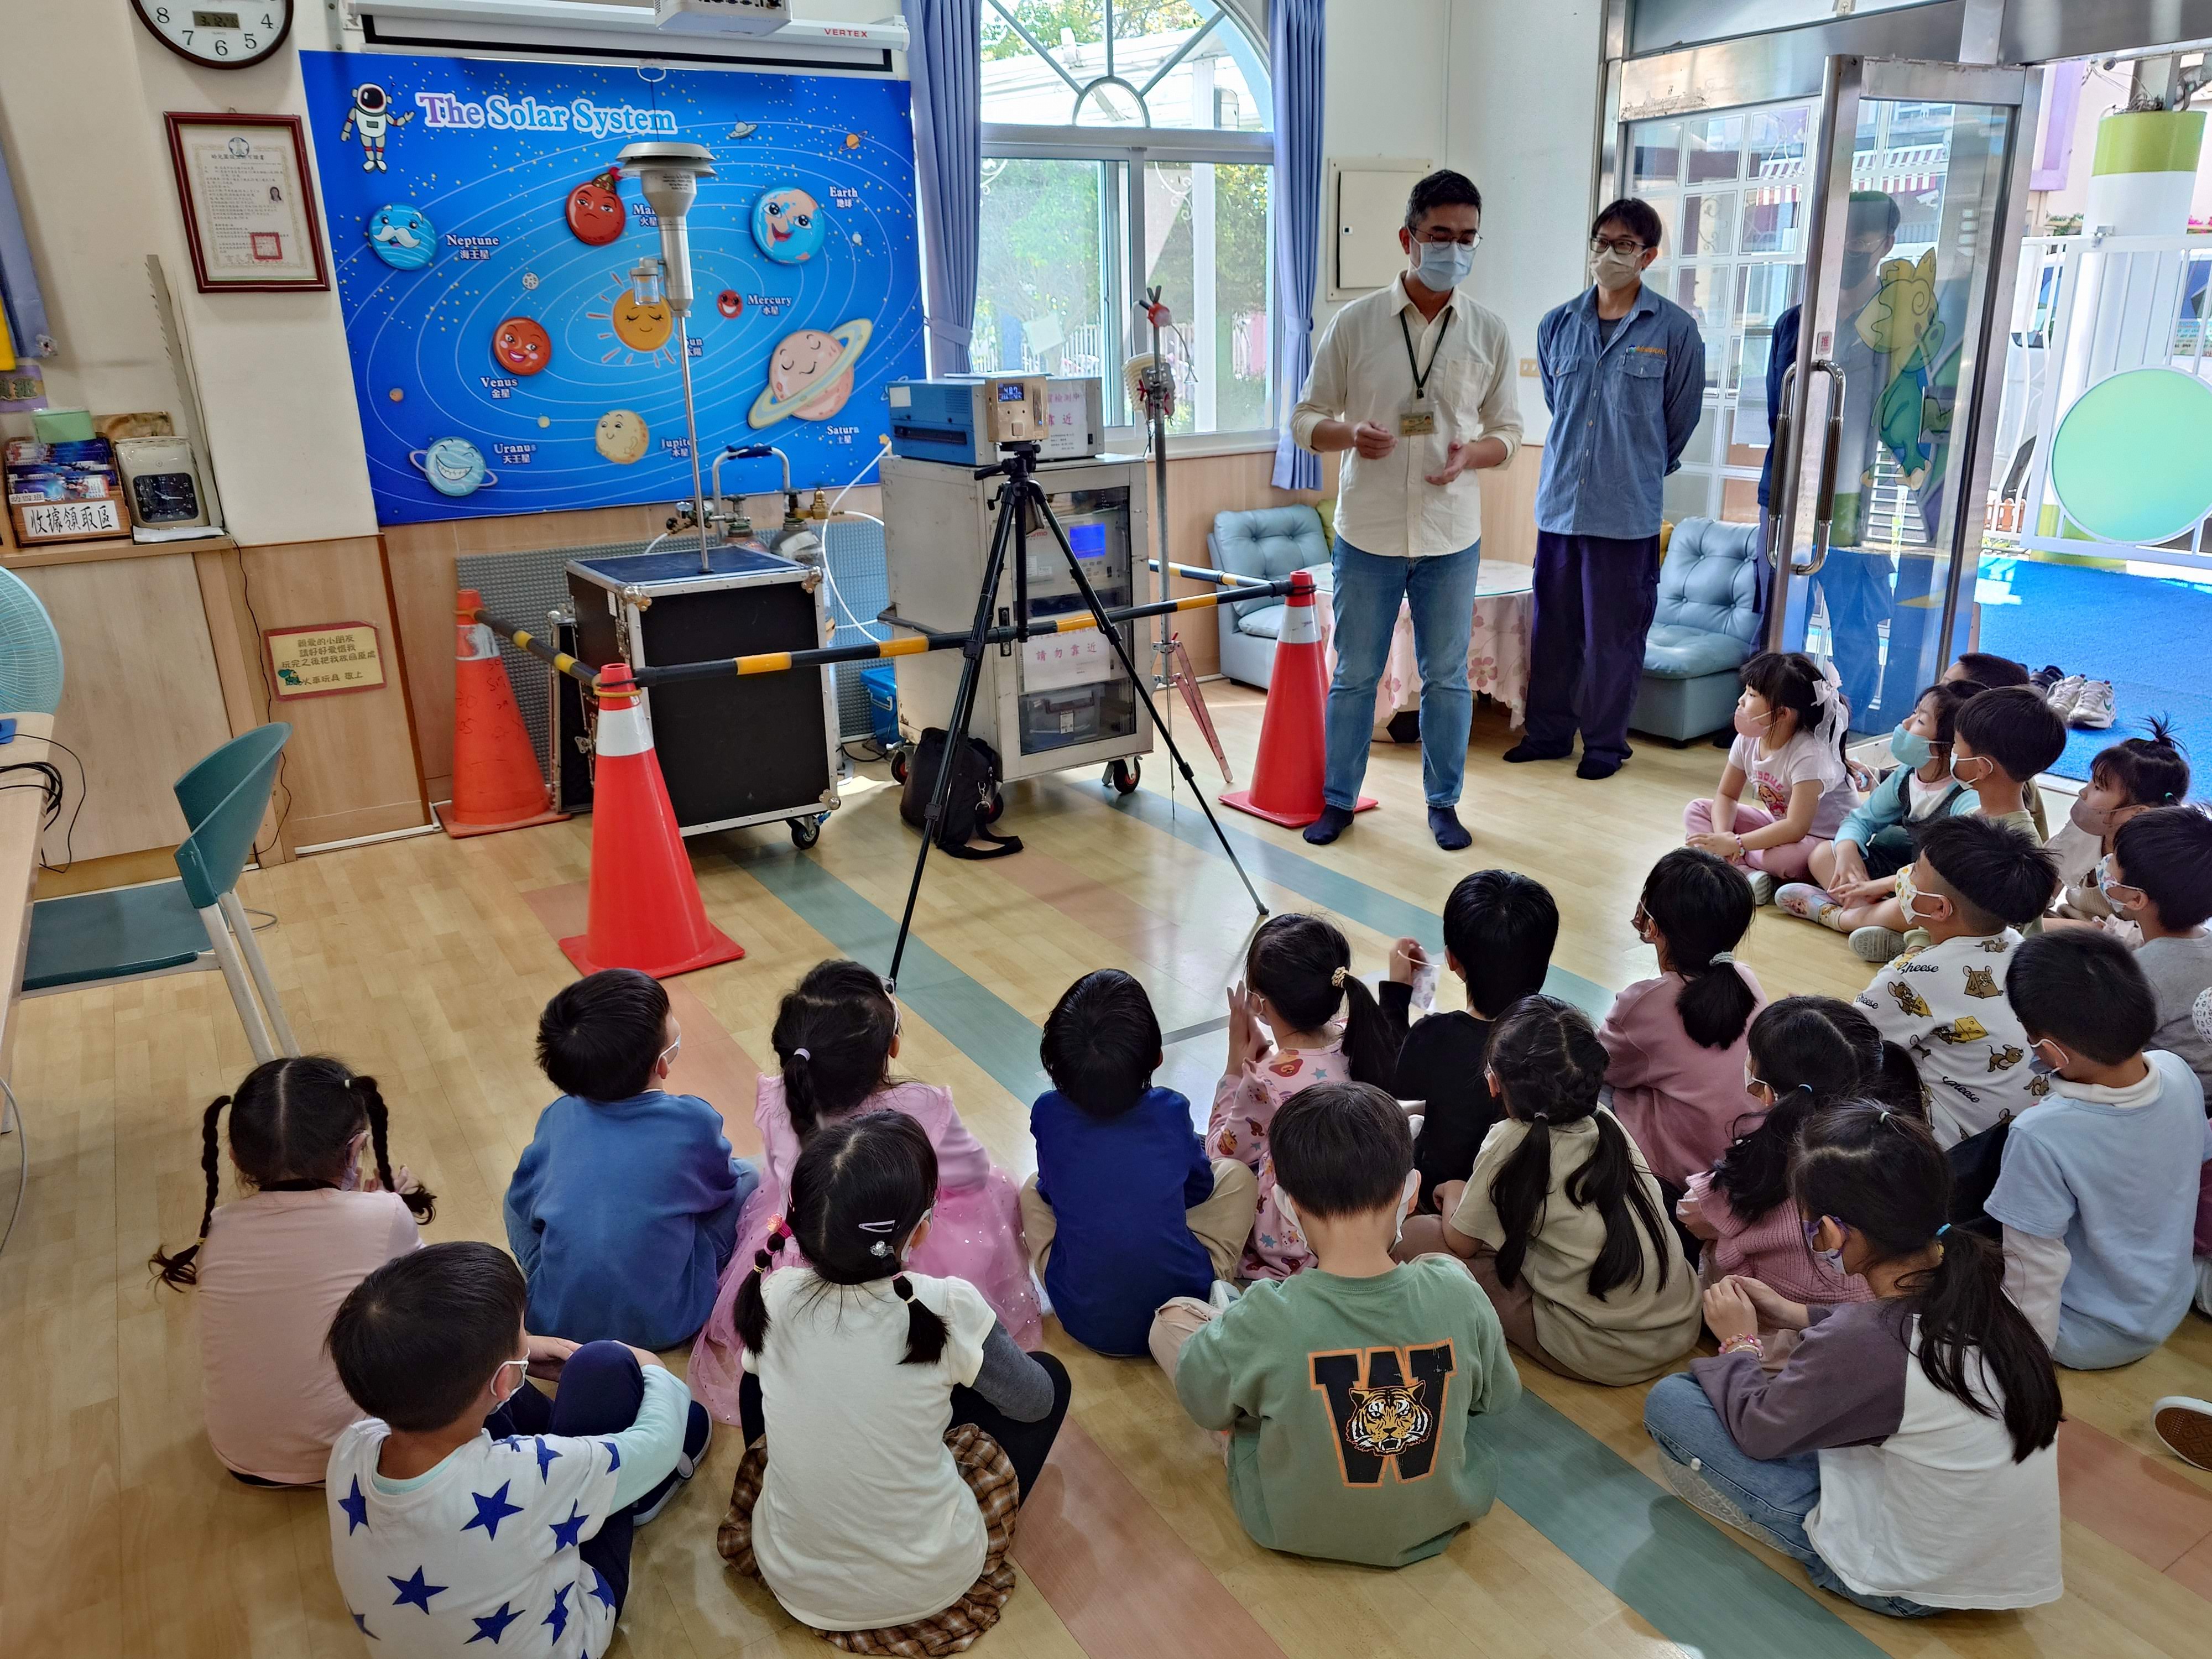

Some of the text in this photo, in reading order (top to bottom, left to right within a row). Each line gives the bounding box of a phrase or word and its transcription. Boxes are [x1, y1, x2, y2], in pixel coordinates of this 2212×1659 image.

[156, 7, 170, 23] 8
[260, 13, 274, 29] 4
[182, 30, 194, 45] 7
[824, 28, 868, 38] VERTEX
[215, 40, 228, 55] 6
[244, 33, 257, 49] 5
[419, 96, 675, 135] The Solar System
[829, 186, 858, 197] Earth
[633, 204, 656, 215] Mar
[836, 198, 853, 208] 地球
[640, 216, 658, 226] 火星
[445, 234, 499, 248] Neptune
[460, 249, 489, 259] 海王星
[748, 295, 791, 306] Mercury
[480, 377, 518, 387] Venus
[492, 388, 510, 398] 金星
[827, 425, 859, 435] Saturn
[493, 444, 536, 453] Uranus
[661, 436, 699, 450] Jupite
[503, 453, 531, 463] 天王星
[31, 504, 113, 535] 收據領取區
[298, 634, 354, 647] 親愛的小朋友
[1036, 642, 1097, 661] 請勿靠近
[1897, 962, 1939, 975] Cheese
[1308, 1337, 1458, 1488] W
